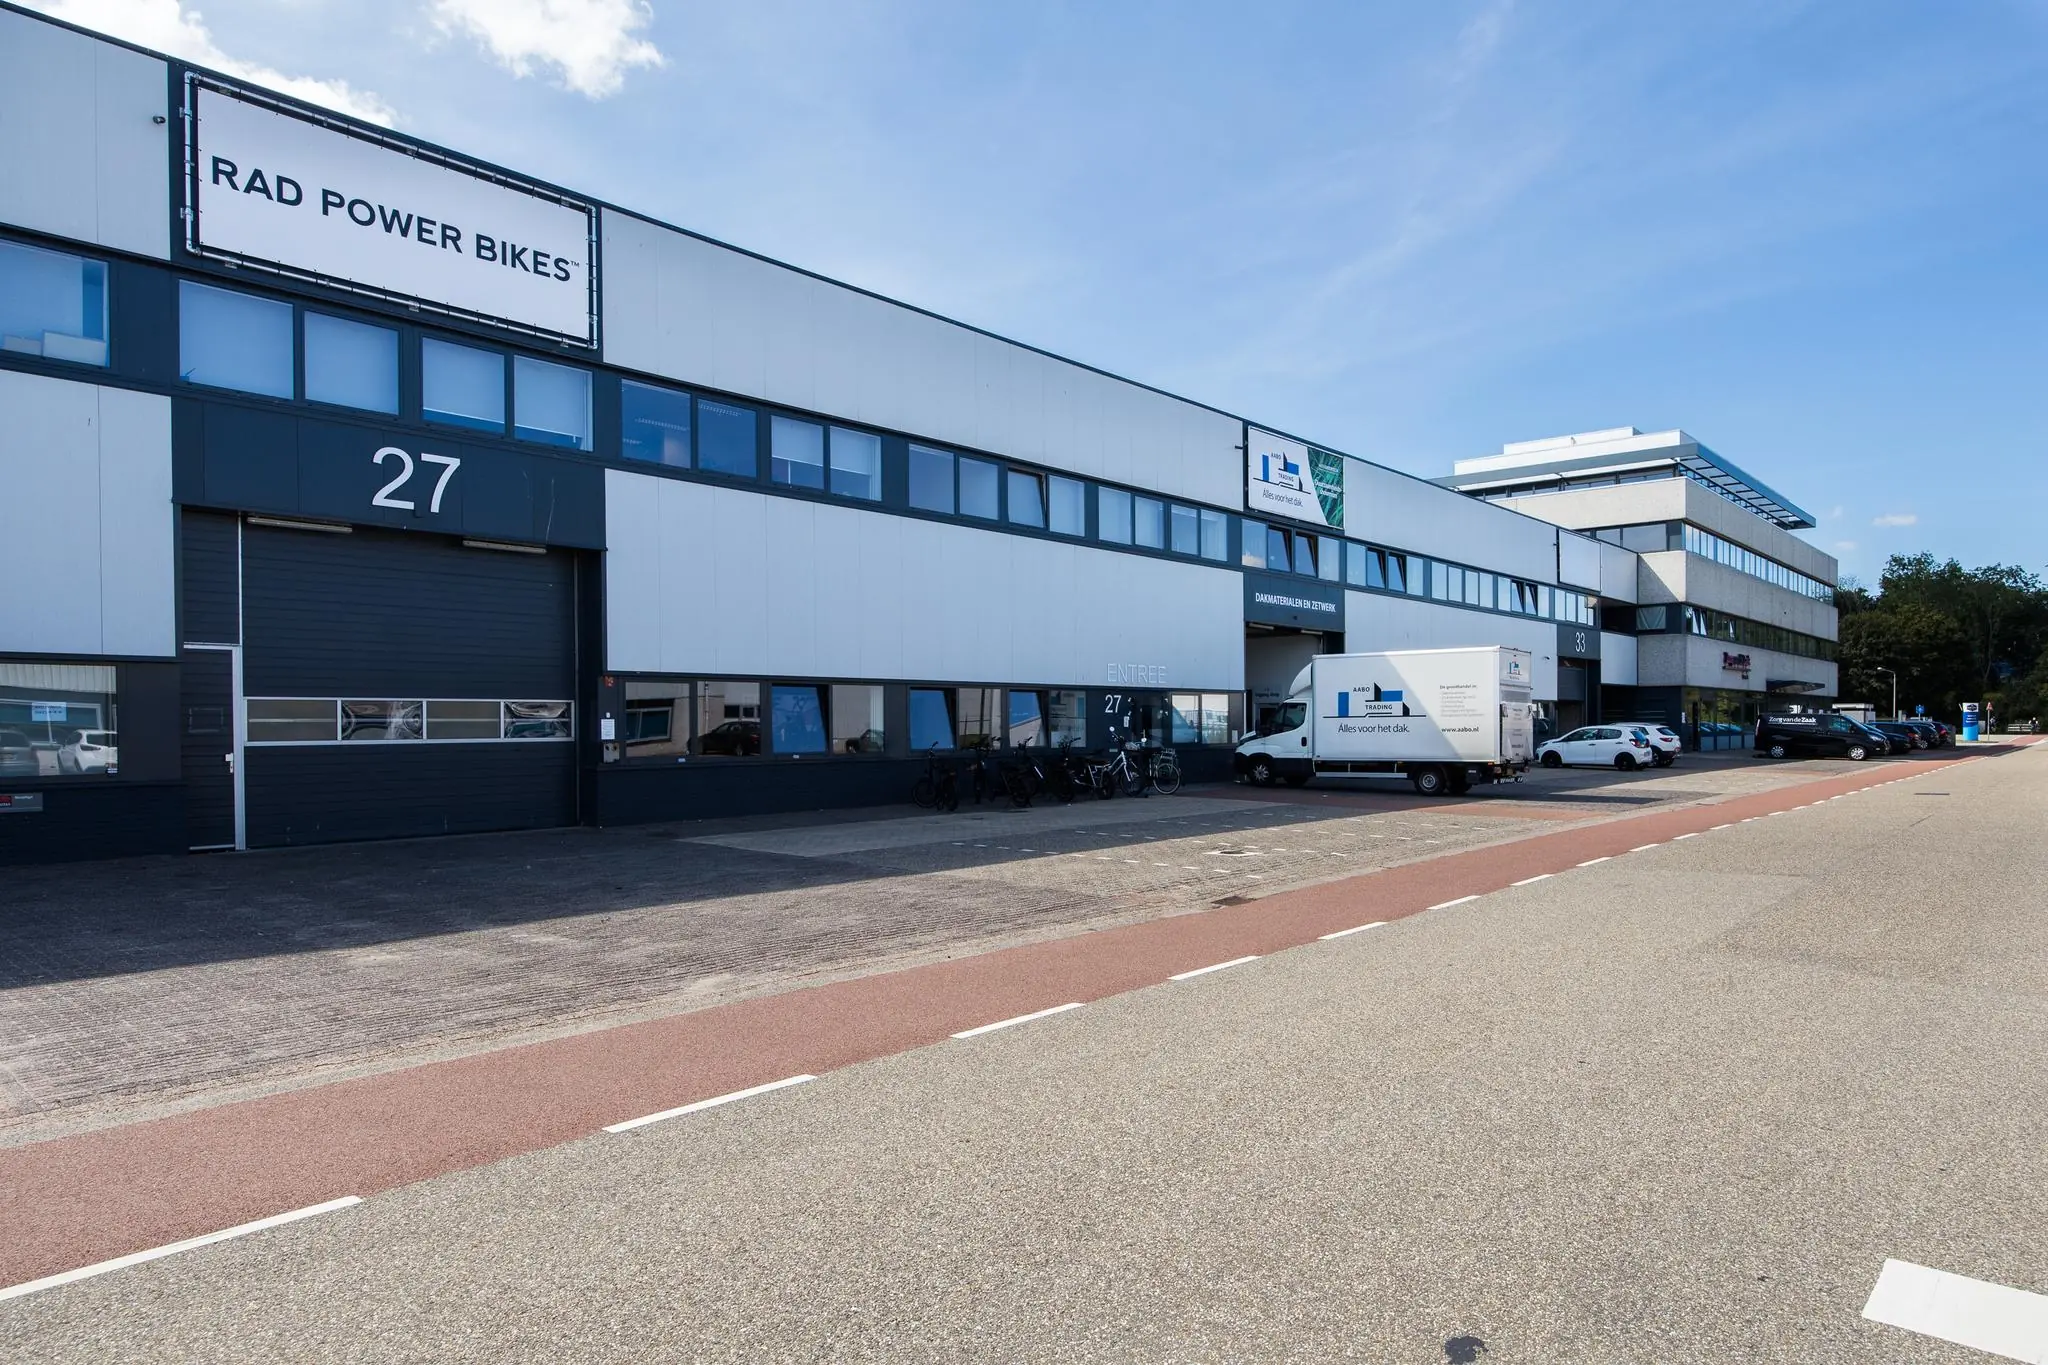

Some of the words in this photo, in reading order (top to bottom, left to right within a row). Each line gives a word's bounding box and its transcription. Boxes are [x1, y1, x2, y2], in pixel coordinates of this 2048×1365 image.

[211, 155, 303, 207] RAD
[321, 188, 463, 254] POWER
[371, 446, 461, 514] 27
[1255, 592, 1303, 608] DAKMATERIALEN
[1303, 600, 1311, 609] EN
[1311, 600, 1337, 613] ZETWERK
[1575, 631, 1586, 653] 33
[1107, 663, 1167, 684] ENTREE
[1104, 694, 1122, 714] 27
[1358, 725, 1377, 733] voor
[1377, 723, 1391, 733] het
